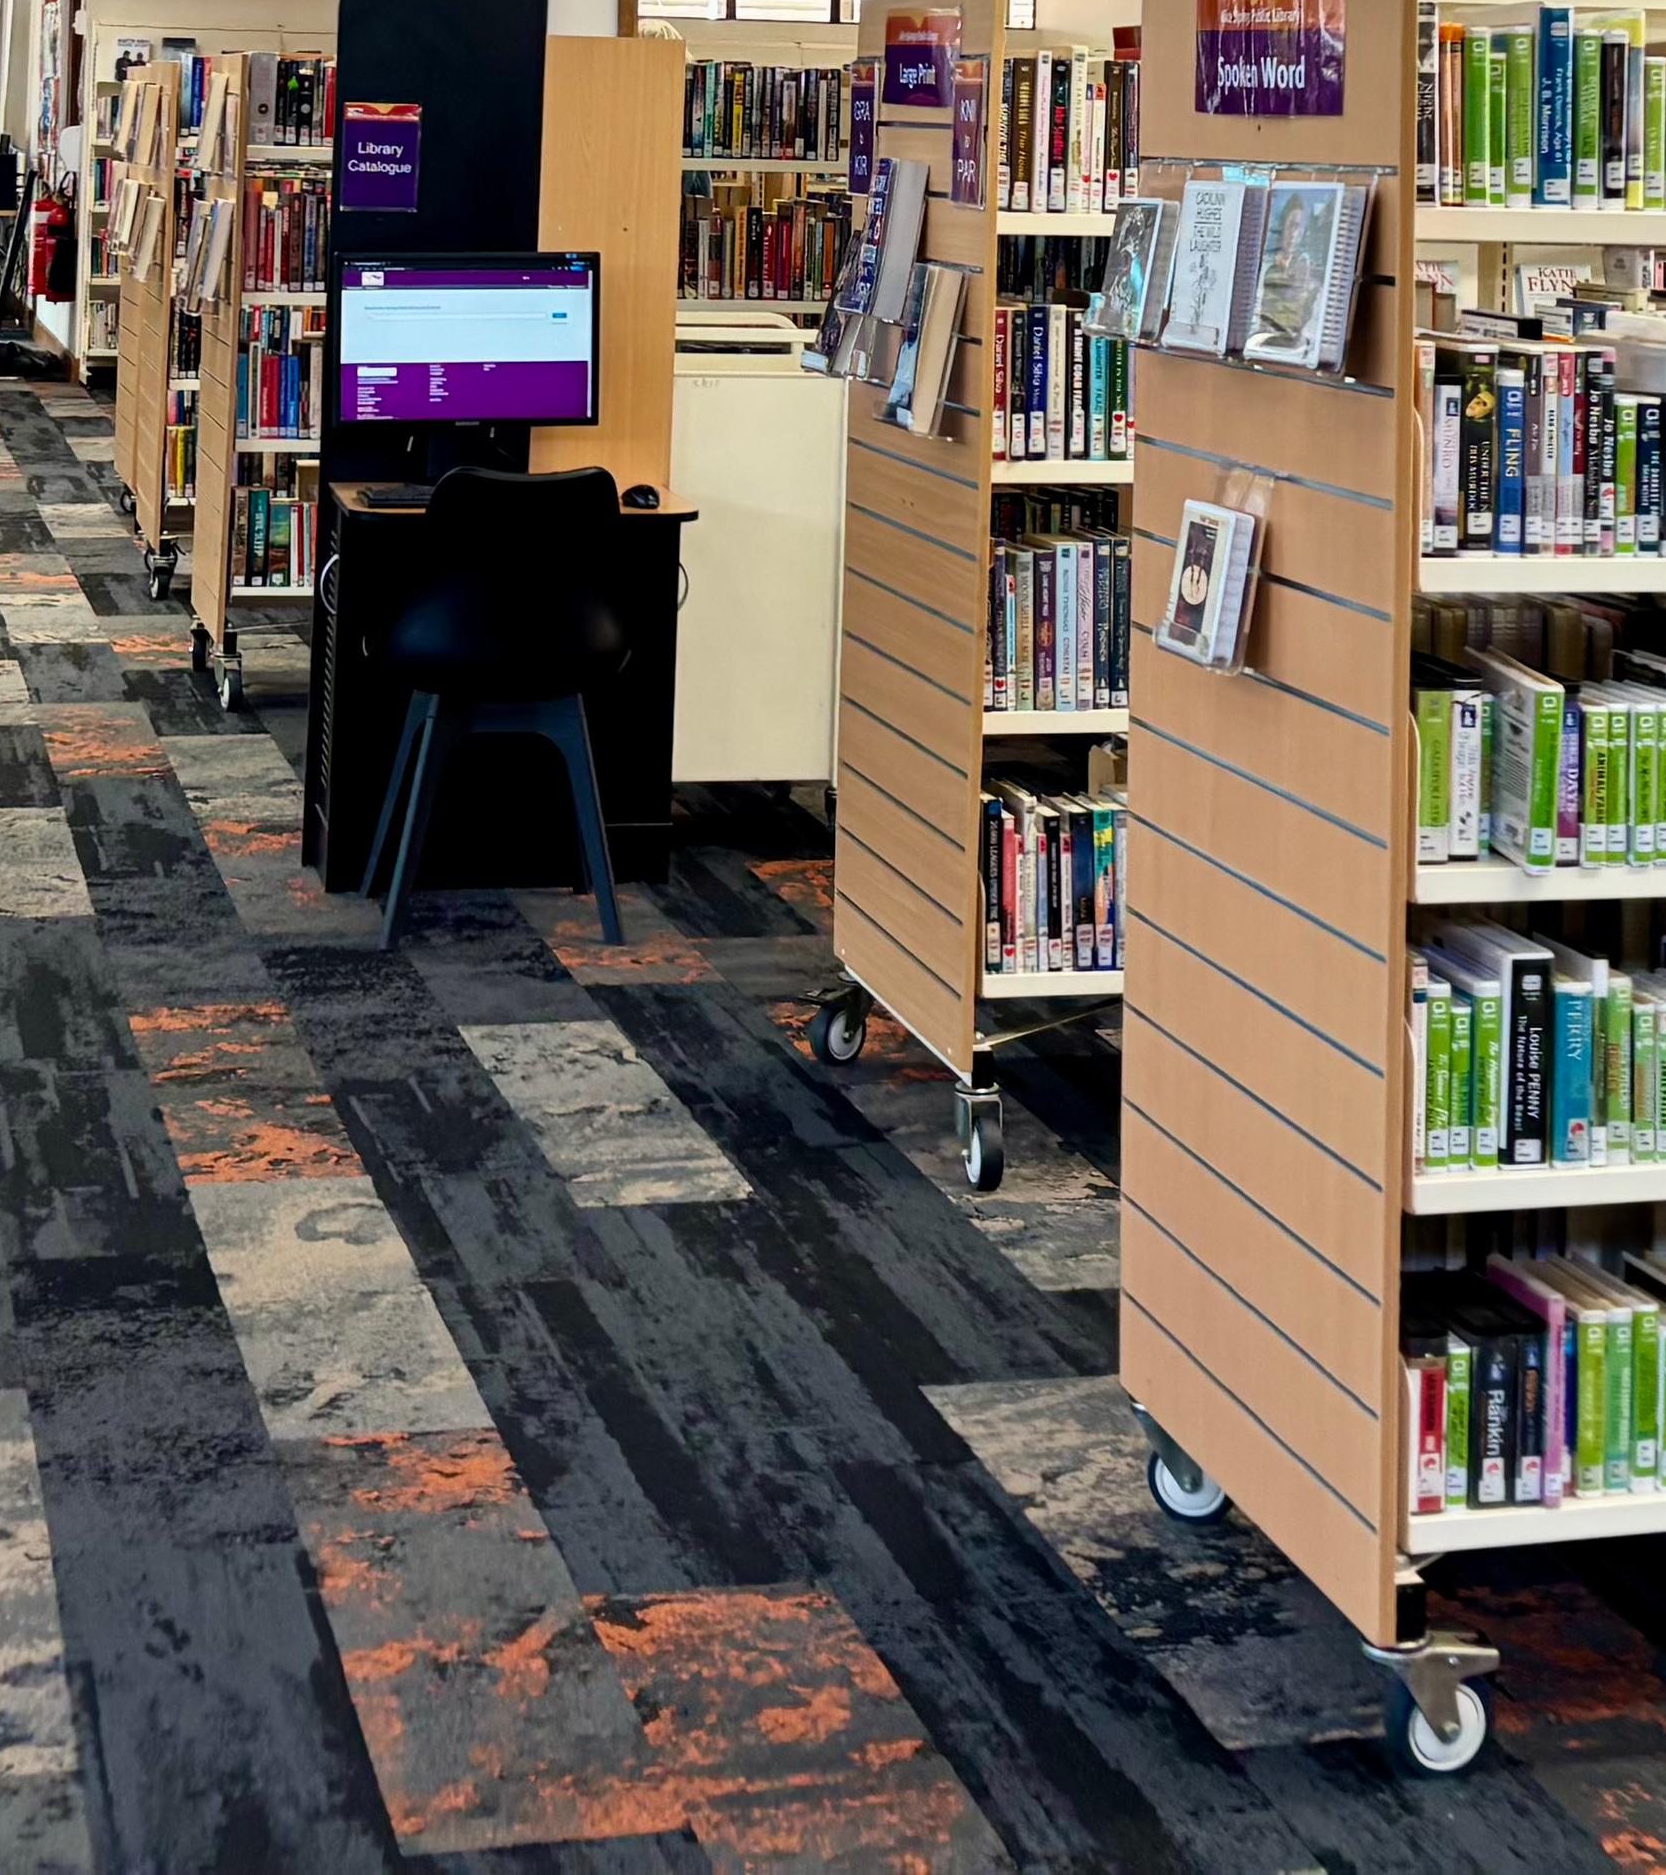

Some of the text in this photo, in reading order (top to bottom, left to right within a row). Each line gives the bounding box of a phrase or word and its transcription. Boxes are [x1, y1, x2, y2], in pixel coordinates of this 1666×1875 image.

[899, 62, 936, 89] Large Print
[1217, 54, 1306, 95] Spoken Word
[1539, 104, 1552, 154] Morrison
[357, 141, 404, 158] Library
[347, 159, 412, 176] Catalogue
[956, 158, 976, 184] PAR
[1529, 277, 1589, 295] FLYN
[1032, 326, 1044, 386] Daniel Silva
[1589, 389, 1601, 402] Jo
[1604, 418, 1615, 433] Jo
[1504, 428, 1521, 477] FLING
[1467, 466, 1477, 510] MURDOC
[1517, 1015, 1528, 1032] The
[1566, 1000, 1583, 1061] PERRY
[1516, 1035, 1528, 1068] Nature
[1516, 1071, 1527, 1082] of
[1526, 1027, 1543, 1119] Louise PENNY
[1515, 1084, 1527, 1101] the
[1486, 1389, 1505, 1456] Rankin
